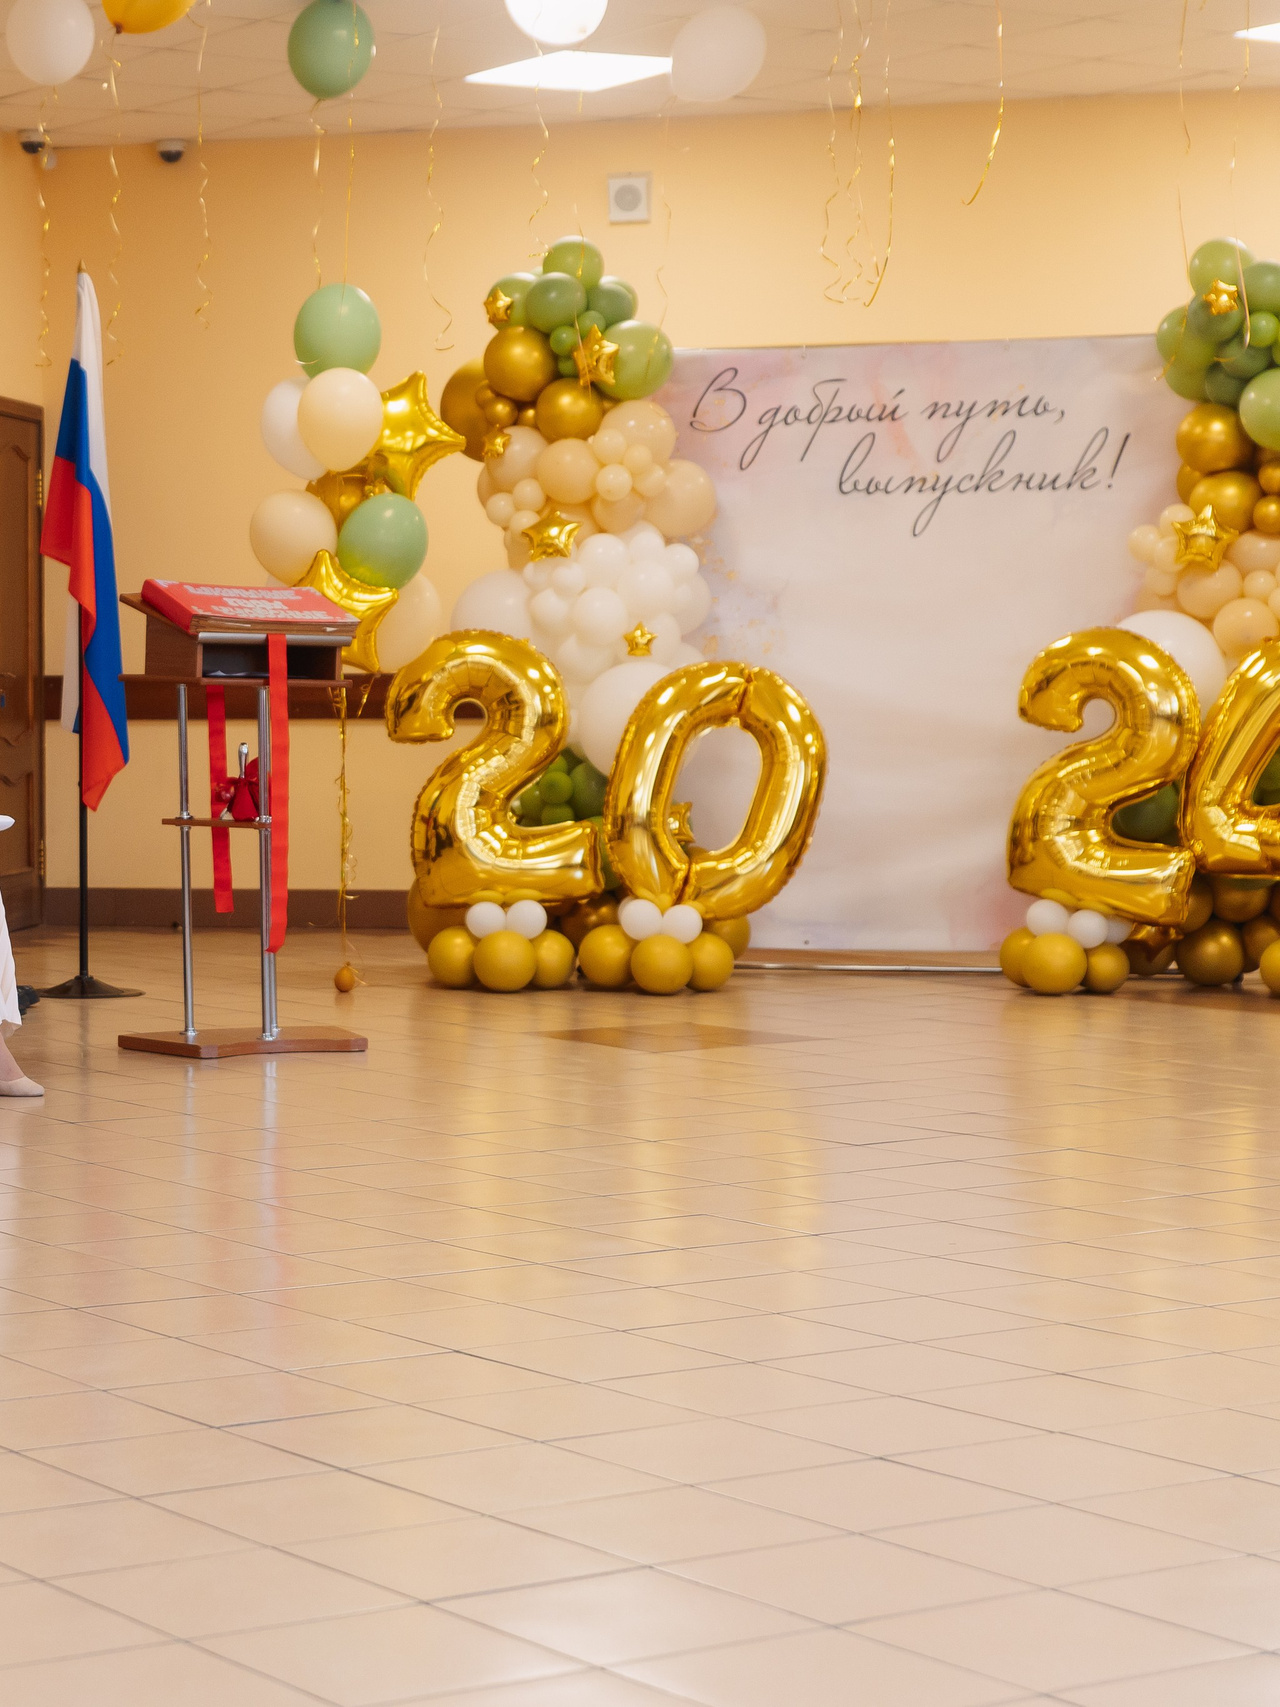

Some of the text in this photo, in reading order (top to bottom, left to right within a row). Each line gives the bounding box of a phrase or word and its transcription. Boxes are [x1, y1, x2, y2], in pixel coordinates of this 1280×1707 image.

[689, 367, 1065, 471] В добрый путь,
[838, 427, 1132, 537] выпускник!
[385, 627, 830, 921] 20
